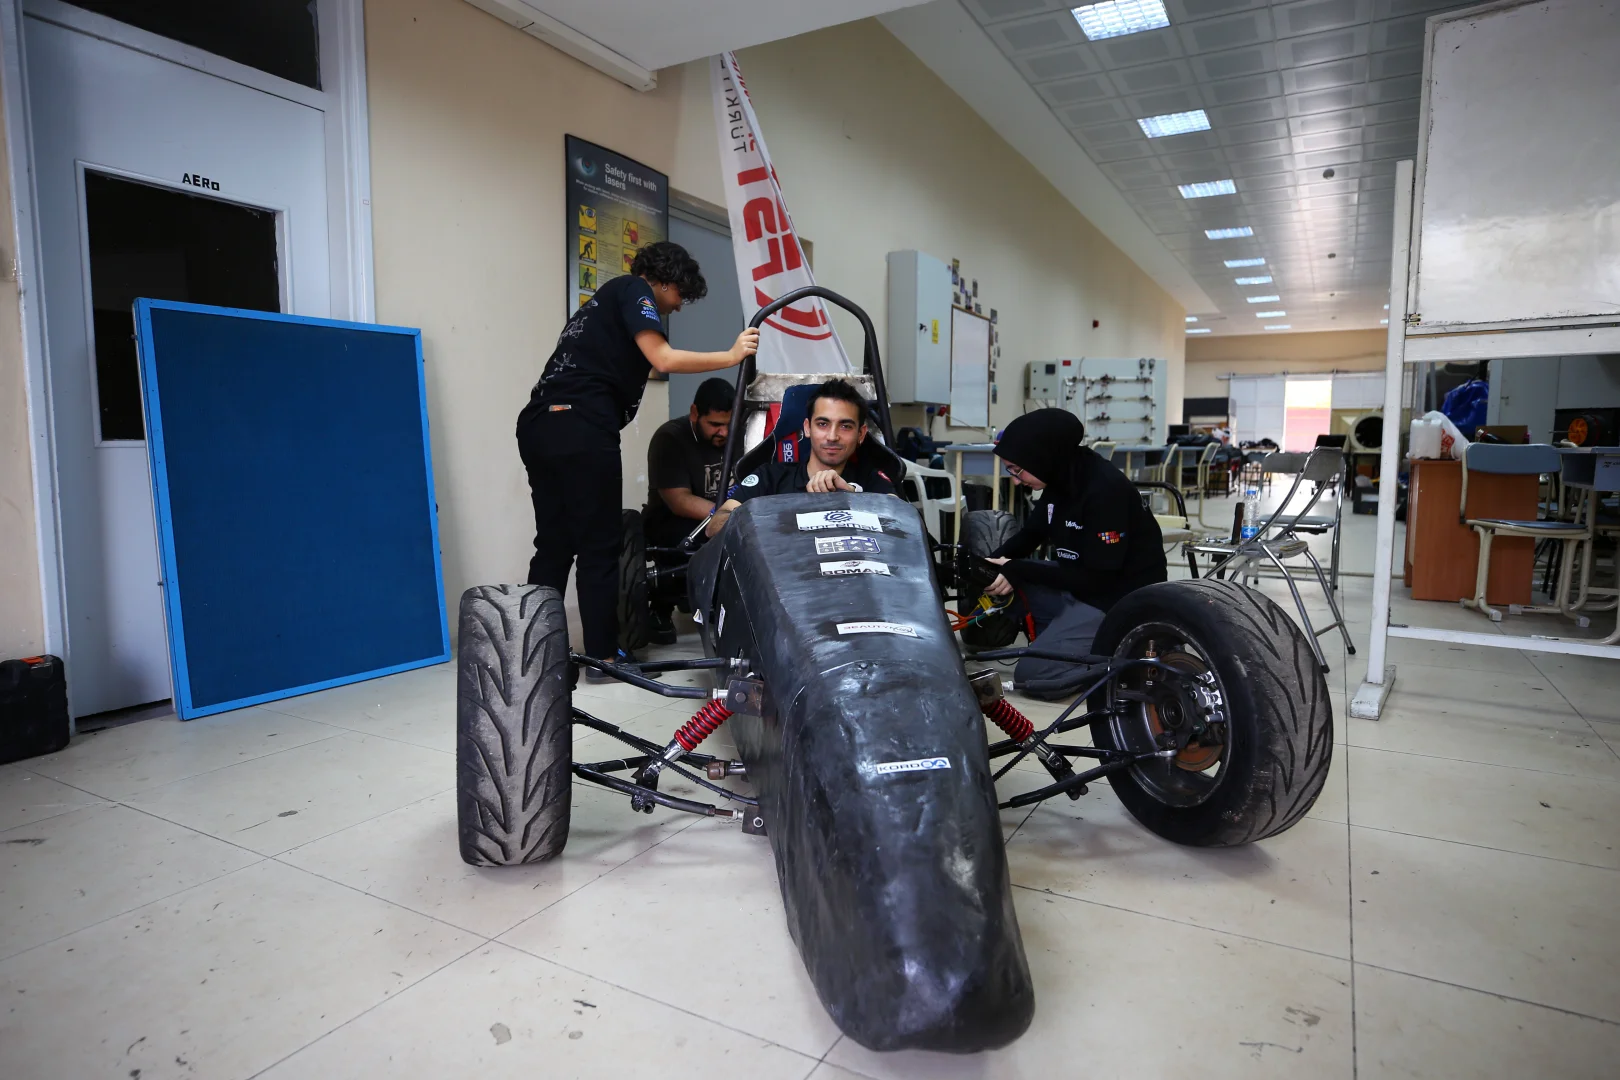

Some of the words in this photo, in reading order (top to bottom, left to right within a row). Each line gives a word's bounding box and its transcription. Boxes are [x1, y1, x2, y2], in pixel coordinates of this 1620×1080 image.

[605, 163, 627, 182] Safety
[628, 172, 642, 186] first
[643, 180, 657, 192] with
[605, 174, 627, 191] lasers
